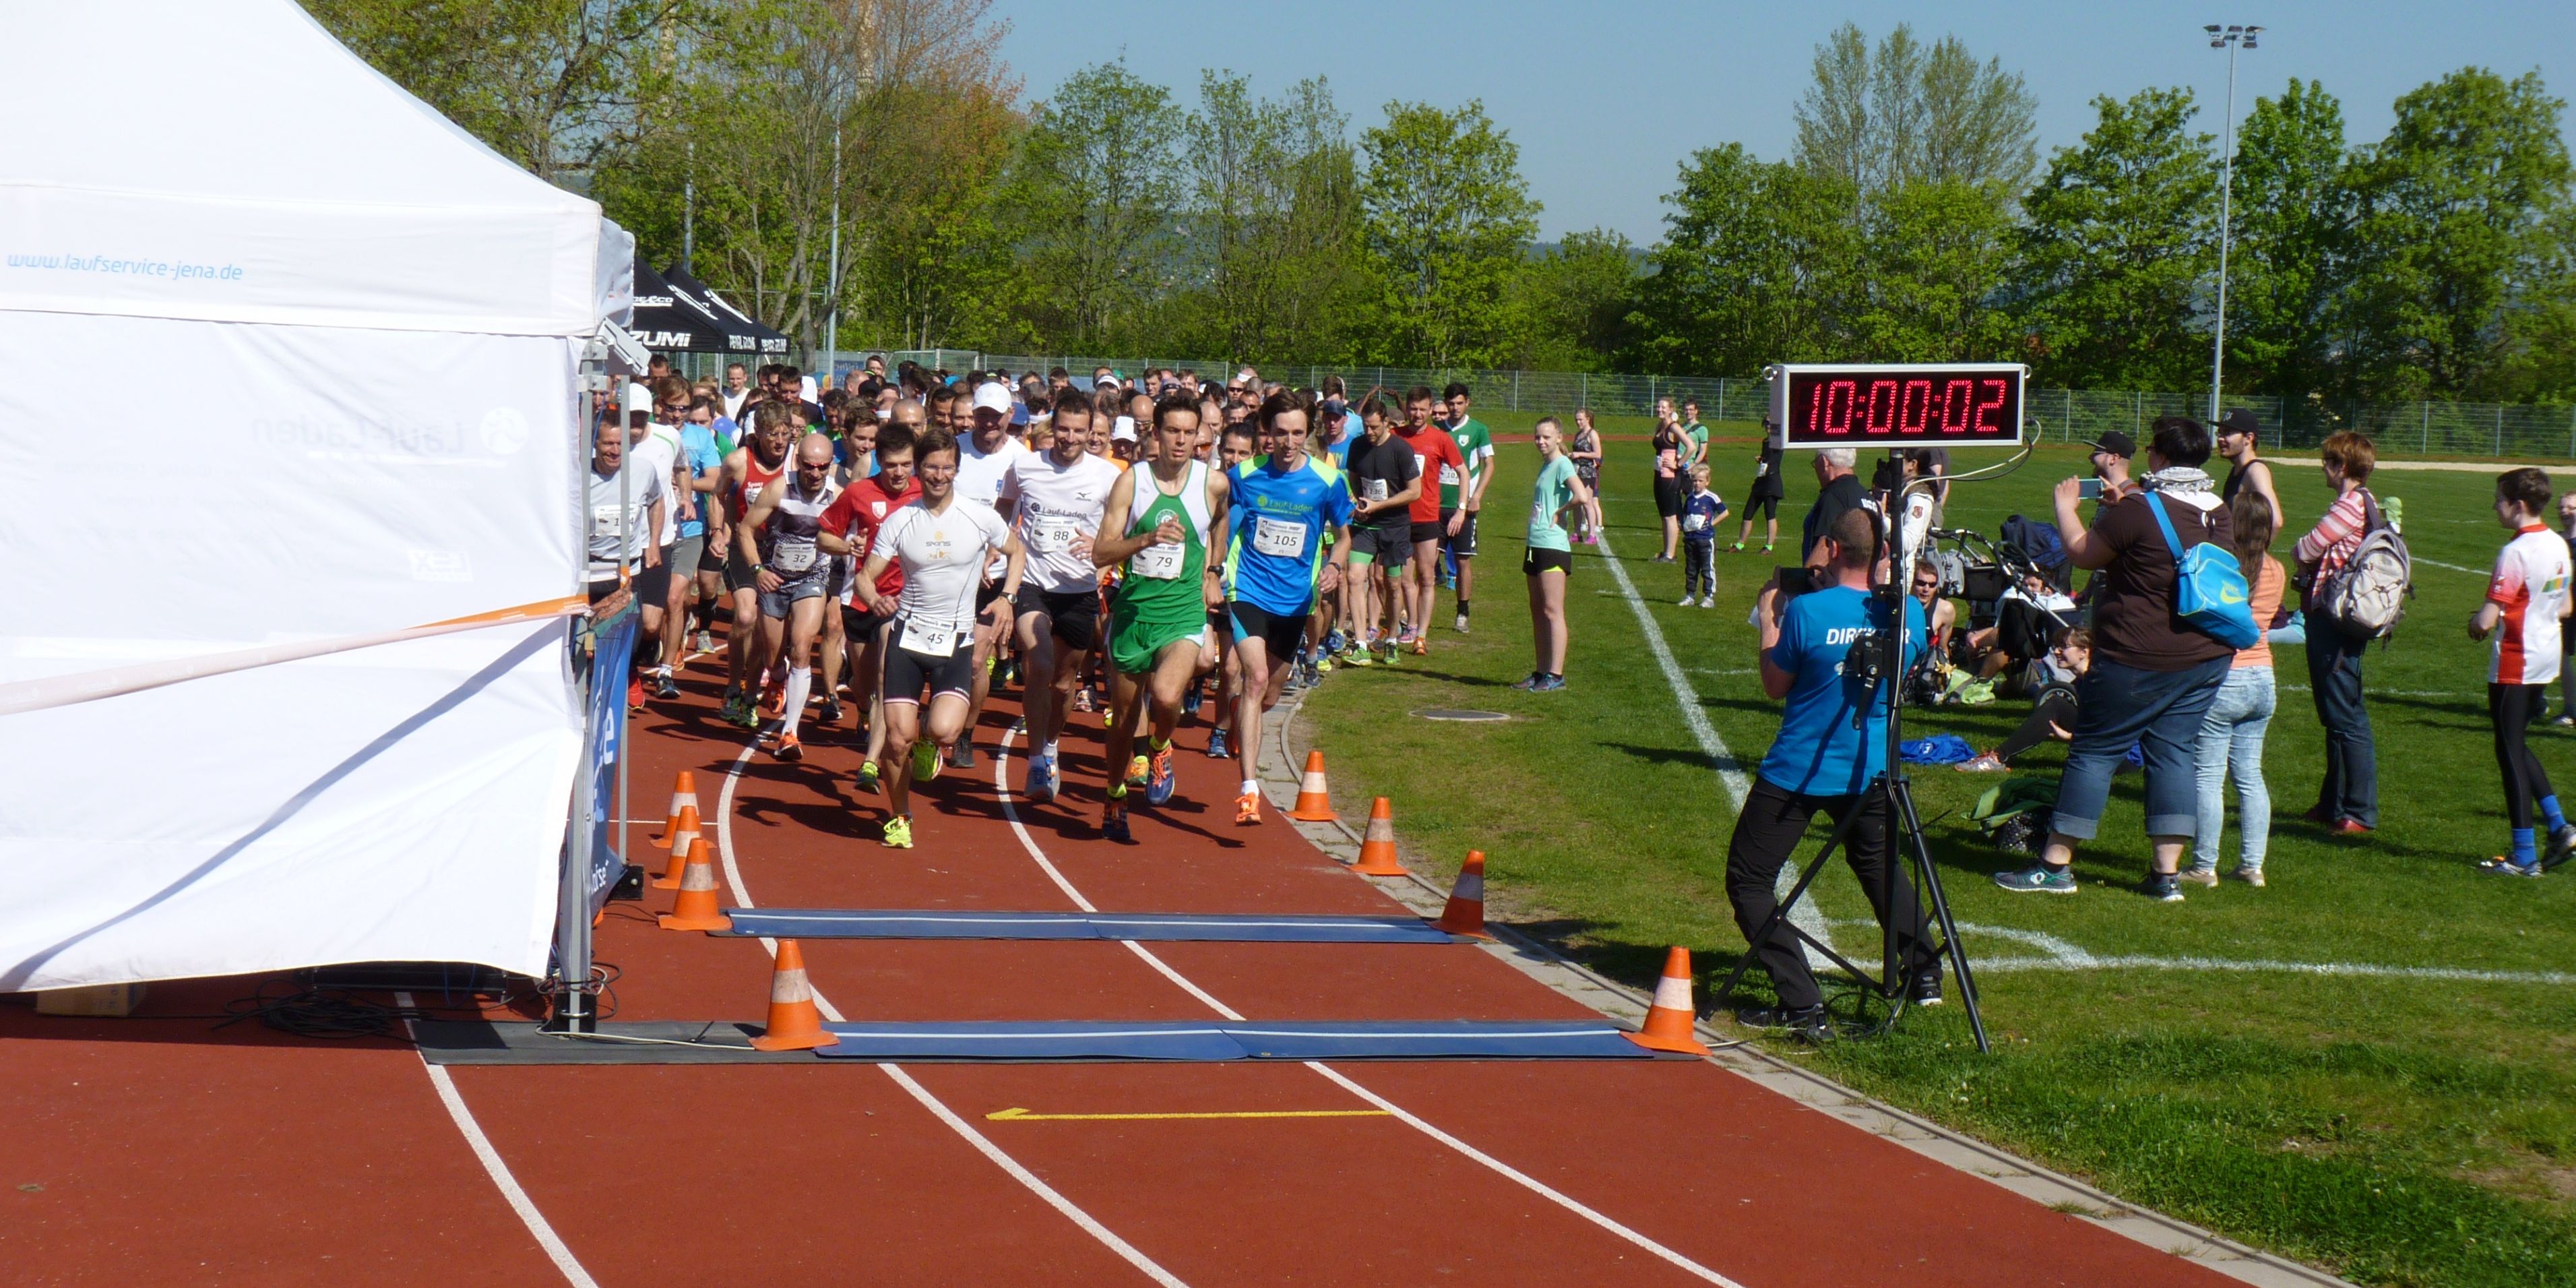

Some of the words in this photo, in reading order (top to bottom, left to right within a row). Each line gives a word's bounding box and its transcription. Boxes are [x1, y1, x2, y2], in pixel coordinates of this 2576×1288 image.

[7, 253, 243, 281] www.laufservice-jena.de
[1809, 379, 2007, 434] 10:00:02
[1269, 499, 1313, 512] Lauf-Laden
[1042, 507, 1087, 519] Lauf-Laden
[1053, 531, 1069, 541] 88
[1274, 535, 1298, 546] 105
[792, 554, 807, 563] 32
[1156, 556, 1172, 567] 79
[926, 633, 945, 644] 45
